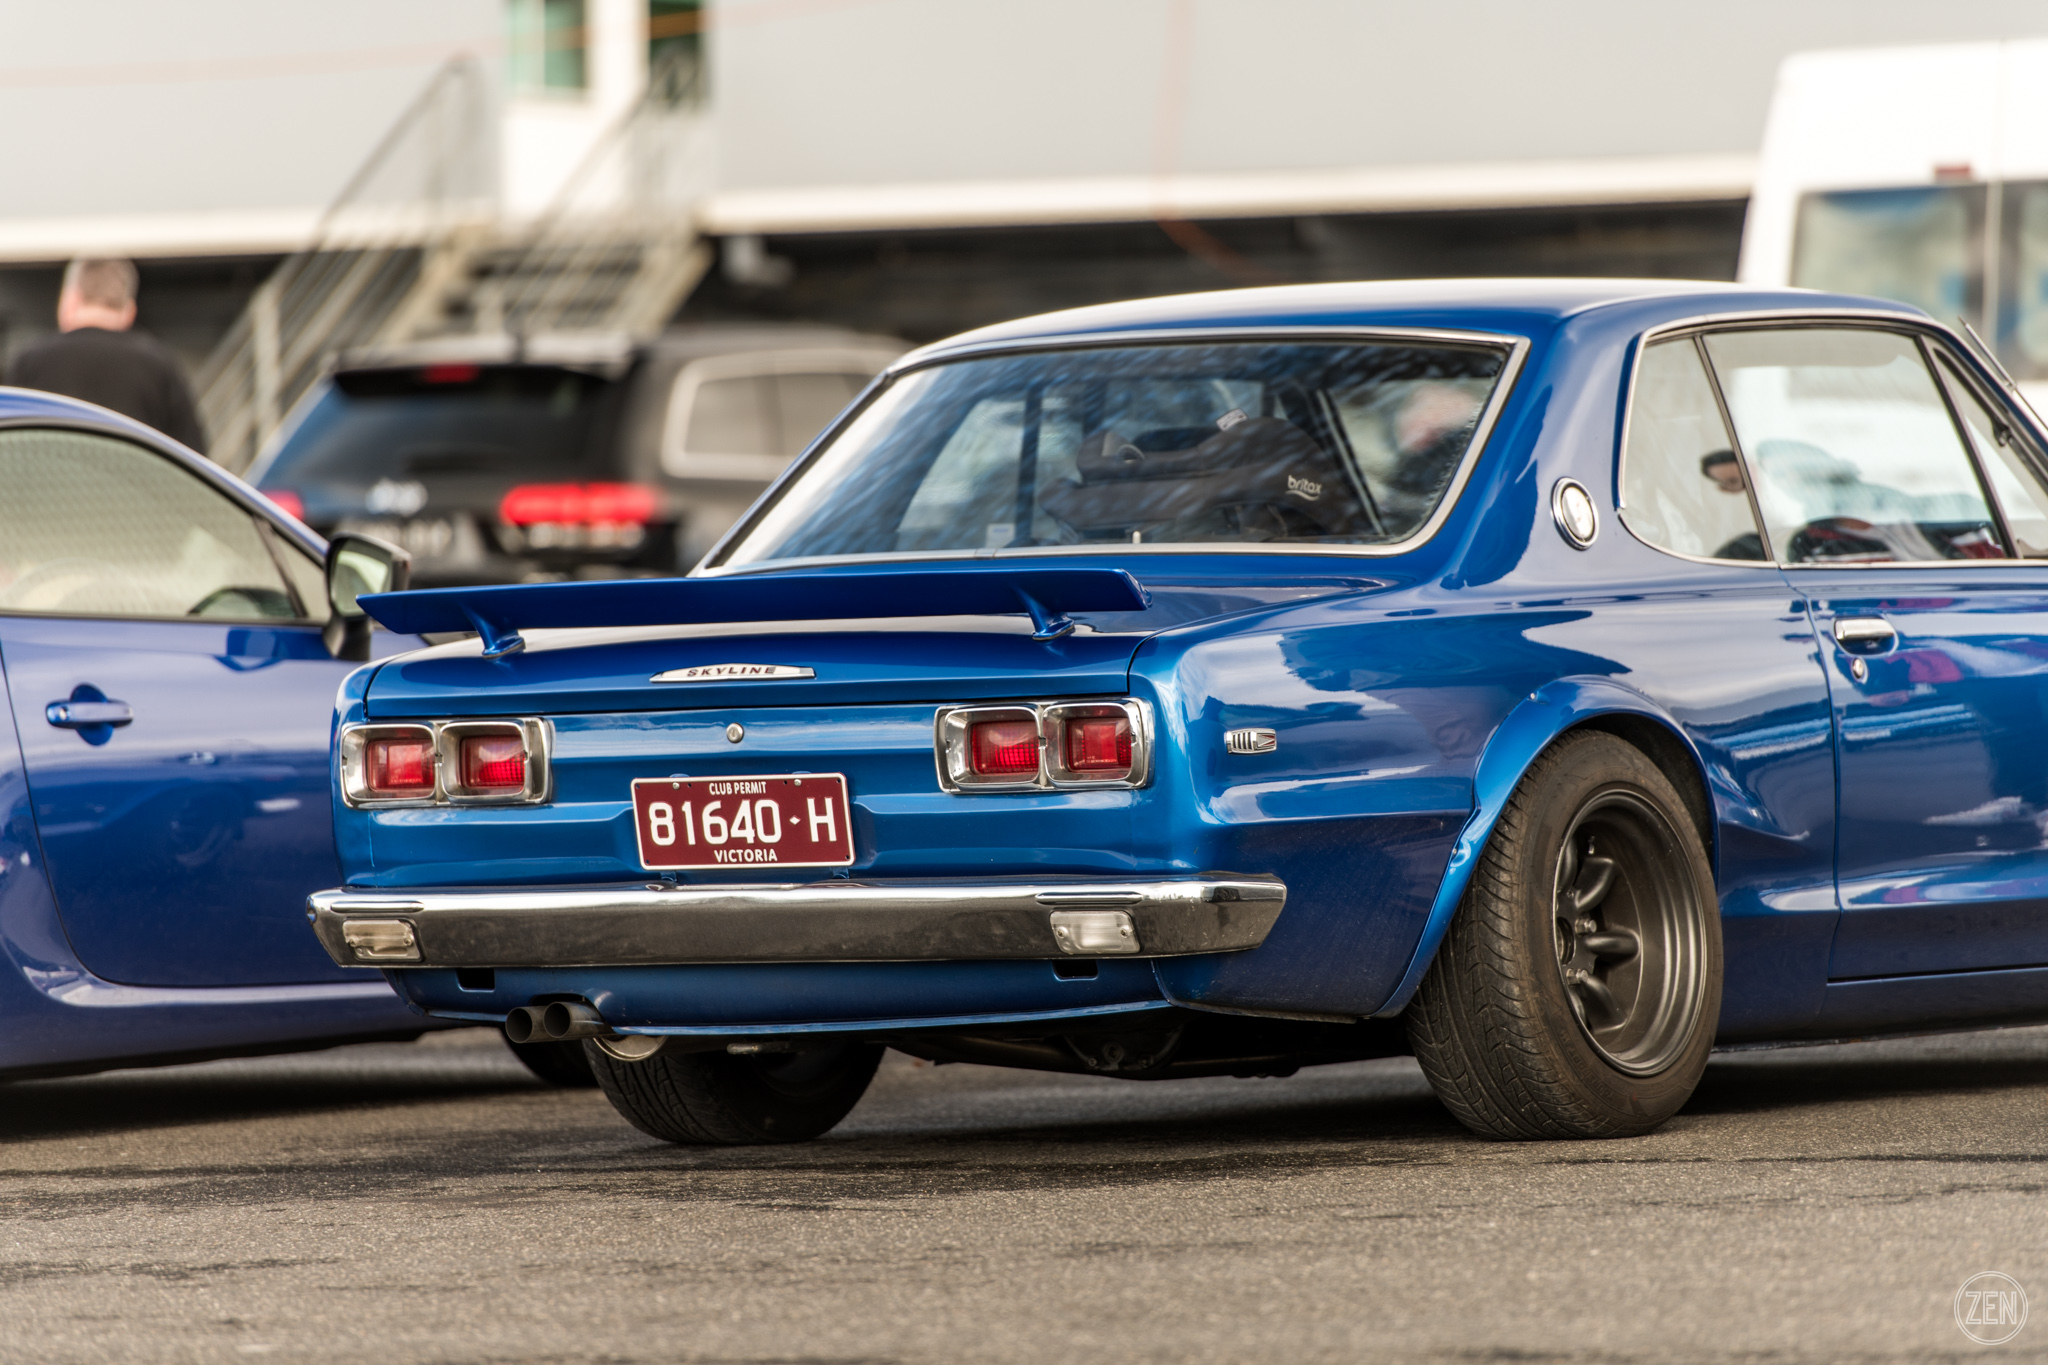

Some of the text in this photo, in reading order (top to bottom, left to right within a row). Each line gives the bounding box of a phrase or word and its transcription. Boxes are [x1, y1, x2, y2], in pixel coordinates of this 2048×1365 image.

[1287, 474, 1322, 494] britax
[687, 666, 777, 677] SKYLINE
[709, 781, 767, 795] CLUB PERMIT
[714, 848, 778, 863] VICTORIA
